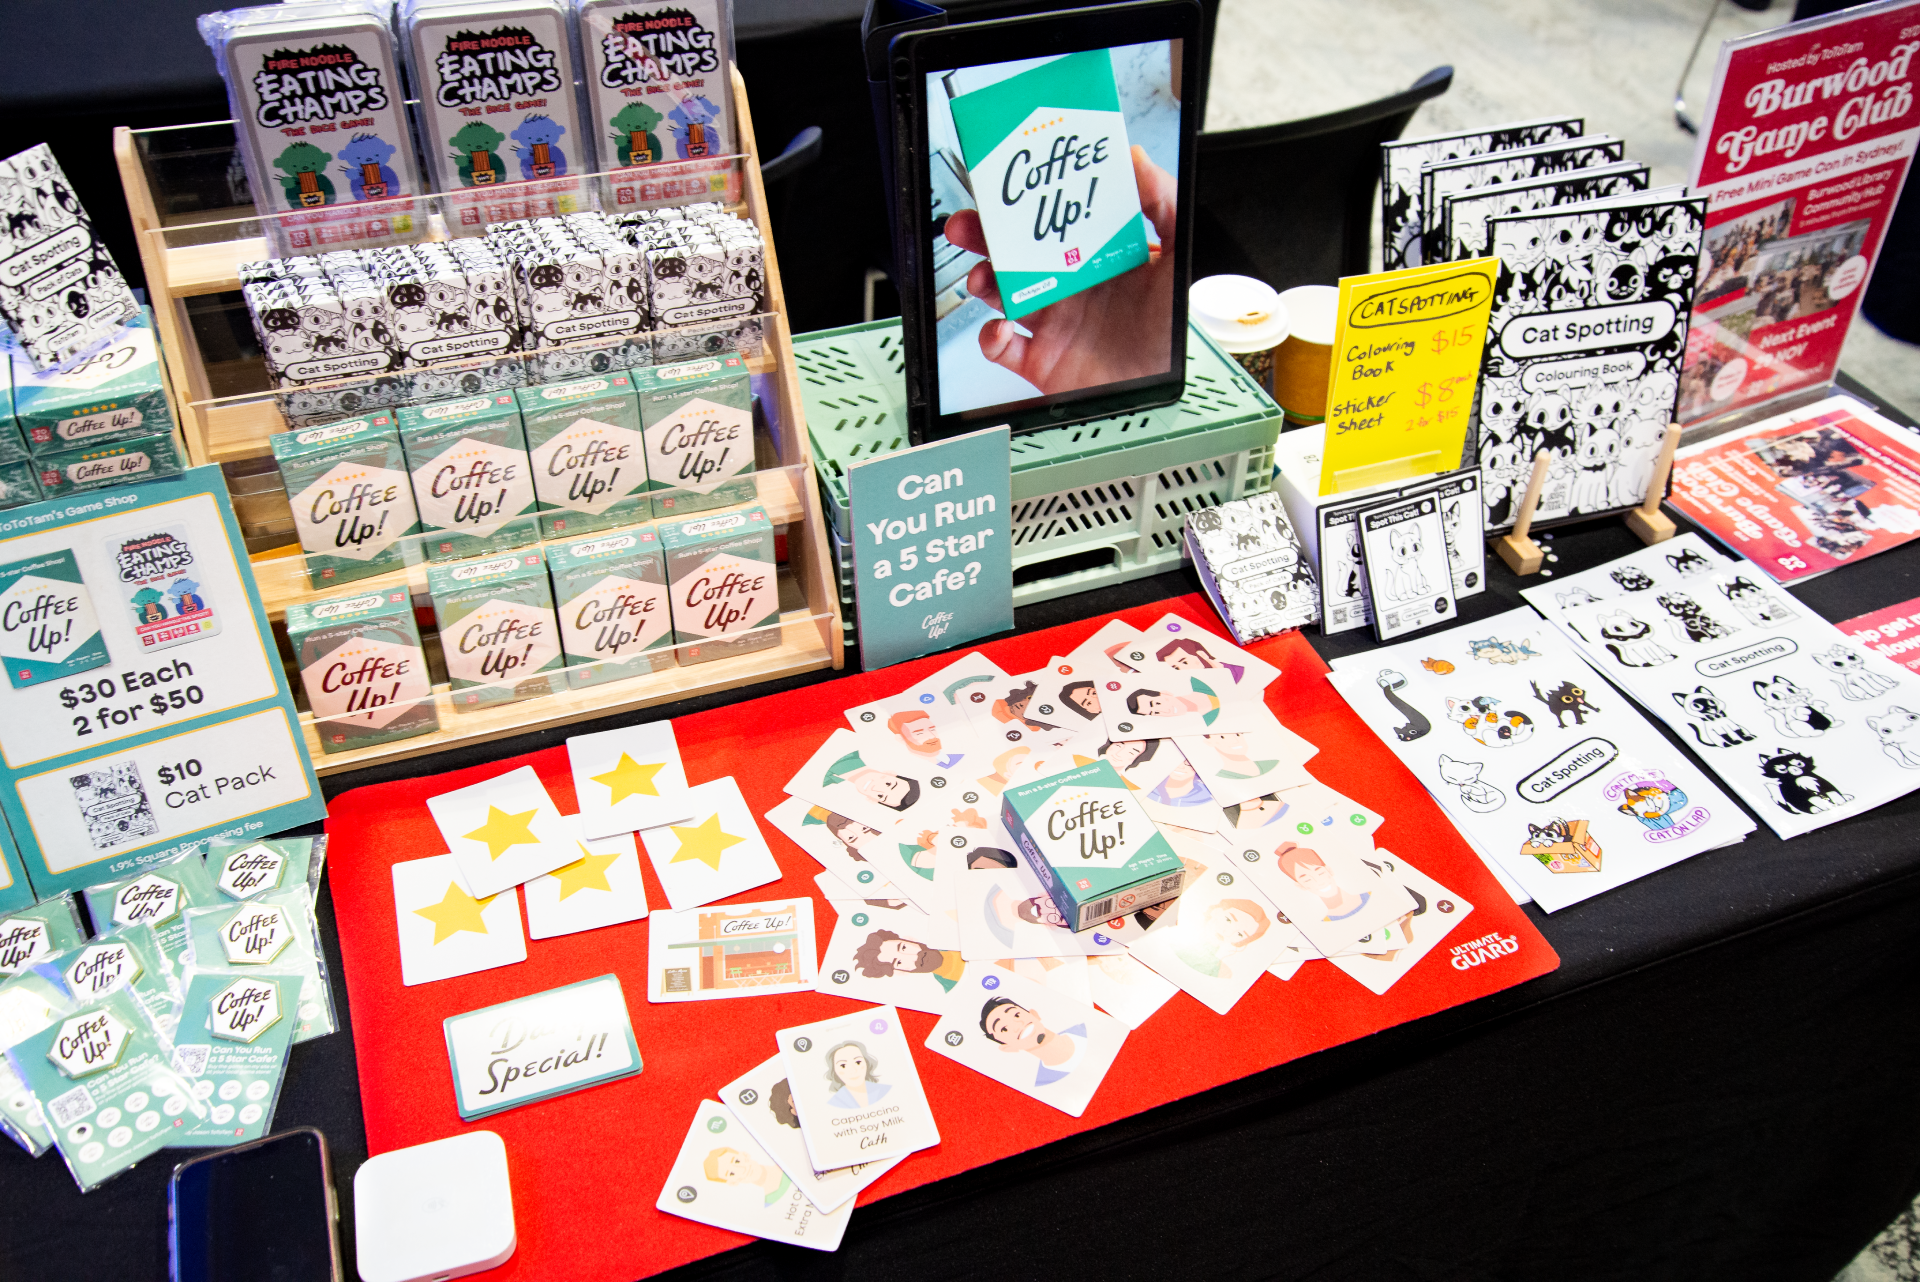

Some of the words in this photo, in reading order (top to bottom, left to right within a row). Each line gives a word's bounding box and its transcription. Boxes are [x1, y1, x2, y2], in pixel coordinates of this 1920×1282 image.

[615, 22, 644, 33] FIRE
[644, 17, 692, 30] NOODLE
[451, 40, 480, 51] FIRE
[481, 36, 531, 48] NOODLE
[603, 27, 713, 63] EATING
[1766, 54, 1807, 75] Hosted
[1807, 51, 1821, 66] by
[1821, 42, 1864, 60] ToToTam
[268, 59, 299, 70] FIRE
[300, 53, 353, 67] NOODLE
[437, 45, 554, 81] EATING
[602, 50, 717, 87] CHAMPS
[255, 63, 379, 101] EATING
[438, 69, 560, 107] CHAMPS
[1744, 41, 1920, 118] Burwood
[258, 87, 387, 127] CHAMPS
[281, 126, 306, 137] THE
[310, 123, 336, 134] DICE
[341, 117, 375, 129] GAME!
[1715, 116, 1829, 173] Game
[1833, 82, 1913, 140] Club
[1002, 135, 1109, 206] Coffee
[1716, 186, 1744, 201] Free
[1747, 176, 1773, 194] Mini
[1776, 167, 1812, 186] Game
[1814, 160, 1840, 175] Con
[1841, 154, 1853, 166] in
[1802, 191, 1862, 216] Community
[1864, 185, 1886, 197] Hub
[1807, 178, 1856, 201] Burwood
[1033, 177, 1099, 242] Up!
[10, 260, 32, 276] Cat
[32, 236, 82, 265] Spotting
[37, 281, 56, 294] Pack
[65, 268, 83, 279] Cats
[555, 323, 578, 334] Cat
[580, 317, 630, 332] Spotting
[674, 310, 695, 320] Cat
[696, 302, 745, 318] Spotting
[1796, 314, 1838, 339] Event
[421, 344, 445, 355] Cat
[447, 337, 499, 353] Spotting
[1347, 338, 1416, 363] Colouring
[1431, 324, 1476, 355] $15
[1522, 325, 1559, 345] Cat
[1564, 315, 1655, 343] Spotting
[298, 365, 322, 375] Cat
[324, 357, 379, 373] Spotting
[1352, 361, 1395, 380] Book
[1535, 364, 1600, 383] Colouring
[1602, 360, 1633, 374] Book
[67, 420, 105, 437] Coffee
[111, 412, 135, 428] Up!
[661, 420, 740, 455] Coffee
[77, 463, 114, 480] Coffee
[120, 456, 143, 473] Up!
[548, 440, 631, 476] Coffee
[679, 447, 730, 483] Up!
[431, 461, 517, 498] Coffee
[568, 467, 620, 503] Up!
[897, 468, 964, 500] Can
[65, 502, 103, 517] Game
[104, 494, 138, 508] Shop
[311, 483, 398, 524] Coffee
[454, 488, 508, 524] Up!
[866, 512, 927, 545] You
[934, 494, 996, 527] Run
[1371, 519, 1388, 529] Spot
[1388, 515, 1403, 524] This
[1403, 511, 1419, 521] Cat!
[335, 510, 389, 551] Up!
[873, 559, 892, 580] a
[899, 546, 919, 571] 5
[925, 528, 995, 564] Star
[1231, 565, 1247, 575] Cat
[1250, 554, 1290, 571] Spotting
[686, 573, 765, 608] Coffee
[889, 561, 982, 607] Cafe?
[3, 594, 79, 632] Coffee
[575, 594, 657, 631] Coffee
[704, 598, 754, 632] Up!
[922, 611, 954, 630] Coffee
[1878, 617, 1915, 637] get
[28, 619, 74, 654] Up!
[459, 619, 544, 655] Coffee
[594, 619, 646, 654] Up!
[928, 622, 949, 639] Up!
[481, 644, 534, 678] Up!
[1707, 658, 1733, 671] Cat
[1734, 641, 1785, 665] Spotting
[59, 678, 116, 710] $30
[121, 658, 194, 693] Each
[322, 657, 410, 694] Coffee
[73, 715, 93, 736] 2
[96, 702, 144, 730] for
[150, 685, 204, 716] $50
[347, 682, 401, 719] Up!
[158, 758, 203, 787] $10
[165, 783, 212, 809] Cat
[214, 764, 277, 795] Pack
[1017, 789, 1033, 799] Run
[1058, 772, 1082, 784] Coffee
[1081, 766, 1101, 778] Shop!
[1531, 776, 1556, 793] Cat
[1551, 747, 1605, 779] Spotting
[1047, 800, 1127, 840] Coffee
[1650, 829, 1672, 841] CAT
[1672, 823, 1688, 836] ON
[1688, 810, 1706, 831] LAP
[109, 860, 134, 874] 1.9%
[135, 847, 178, 867] Square
[179, 827, 243, 851] Processing
[244, 820, 264, 832] fee
[1080, 821, 1126, 859] Up!
[228, 854, 278, 872] Coffee
[121, 884, 174, 906] Coffee
[232, 871, 267, 892] Up!
[229, 913, 279, 942] Coffee
[724, 920, 760, 934] Coffee
[764, 916, 791, 931] Up!
[245, 931, 274, 954] Up!
[1450, 932, 1503, 956] ULTIMATE
[217, 987, 272, 1015] Coffee
[229, 1005, 264, 1031] Up!
[59, 1014, 109, 1060] Coffee
[82, 1031, 111, 1064] Up!
[212, 1046, 233, 1054] Can
[235, 1046, 253, 1054] You
[253, 1046, 273, 1054] Run
[225, 1055, 247, 1063] Star
[248, 1055, 278, 1063] Cafe?
[479, 1032, 609, 1096] Special!
[831, 1105, 900, 1127] Cappuccino
[834, 1125, 858, 1138] with
[860, 1121, 880, 1137] Soy
[881, 1115, 905, 1127] Milk
[860, 1135, 889, 1150] Cath
[785, 1203, 798, 1221] Hot
[795, 1209, 809, 1237] Extra
